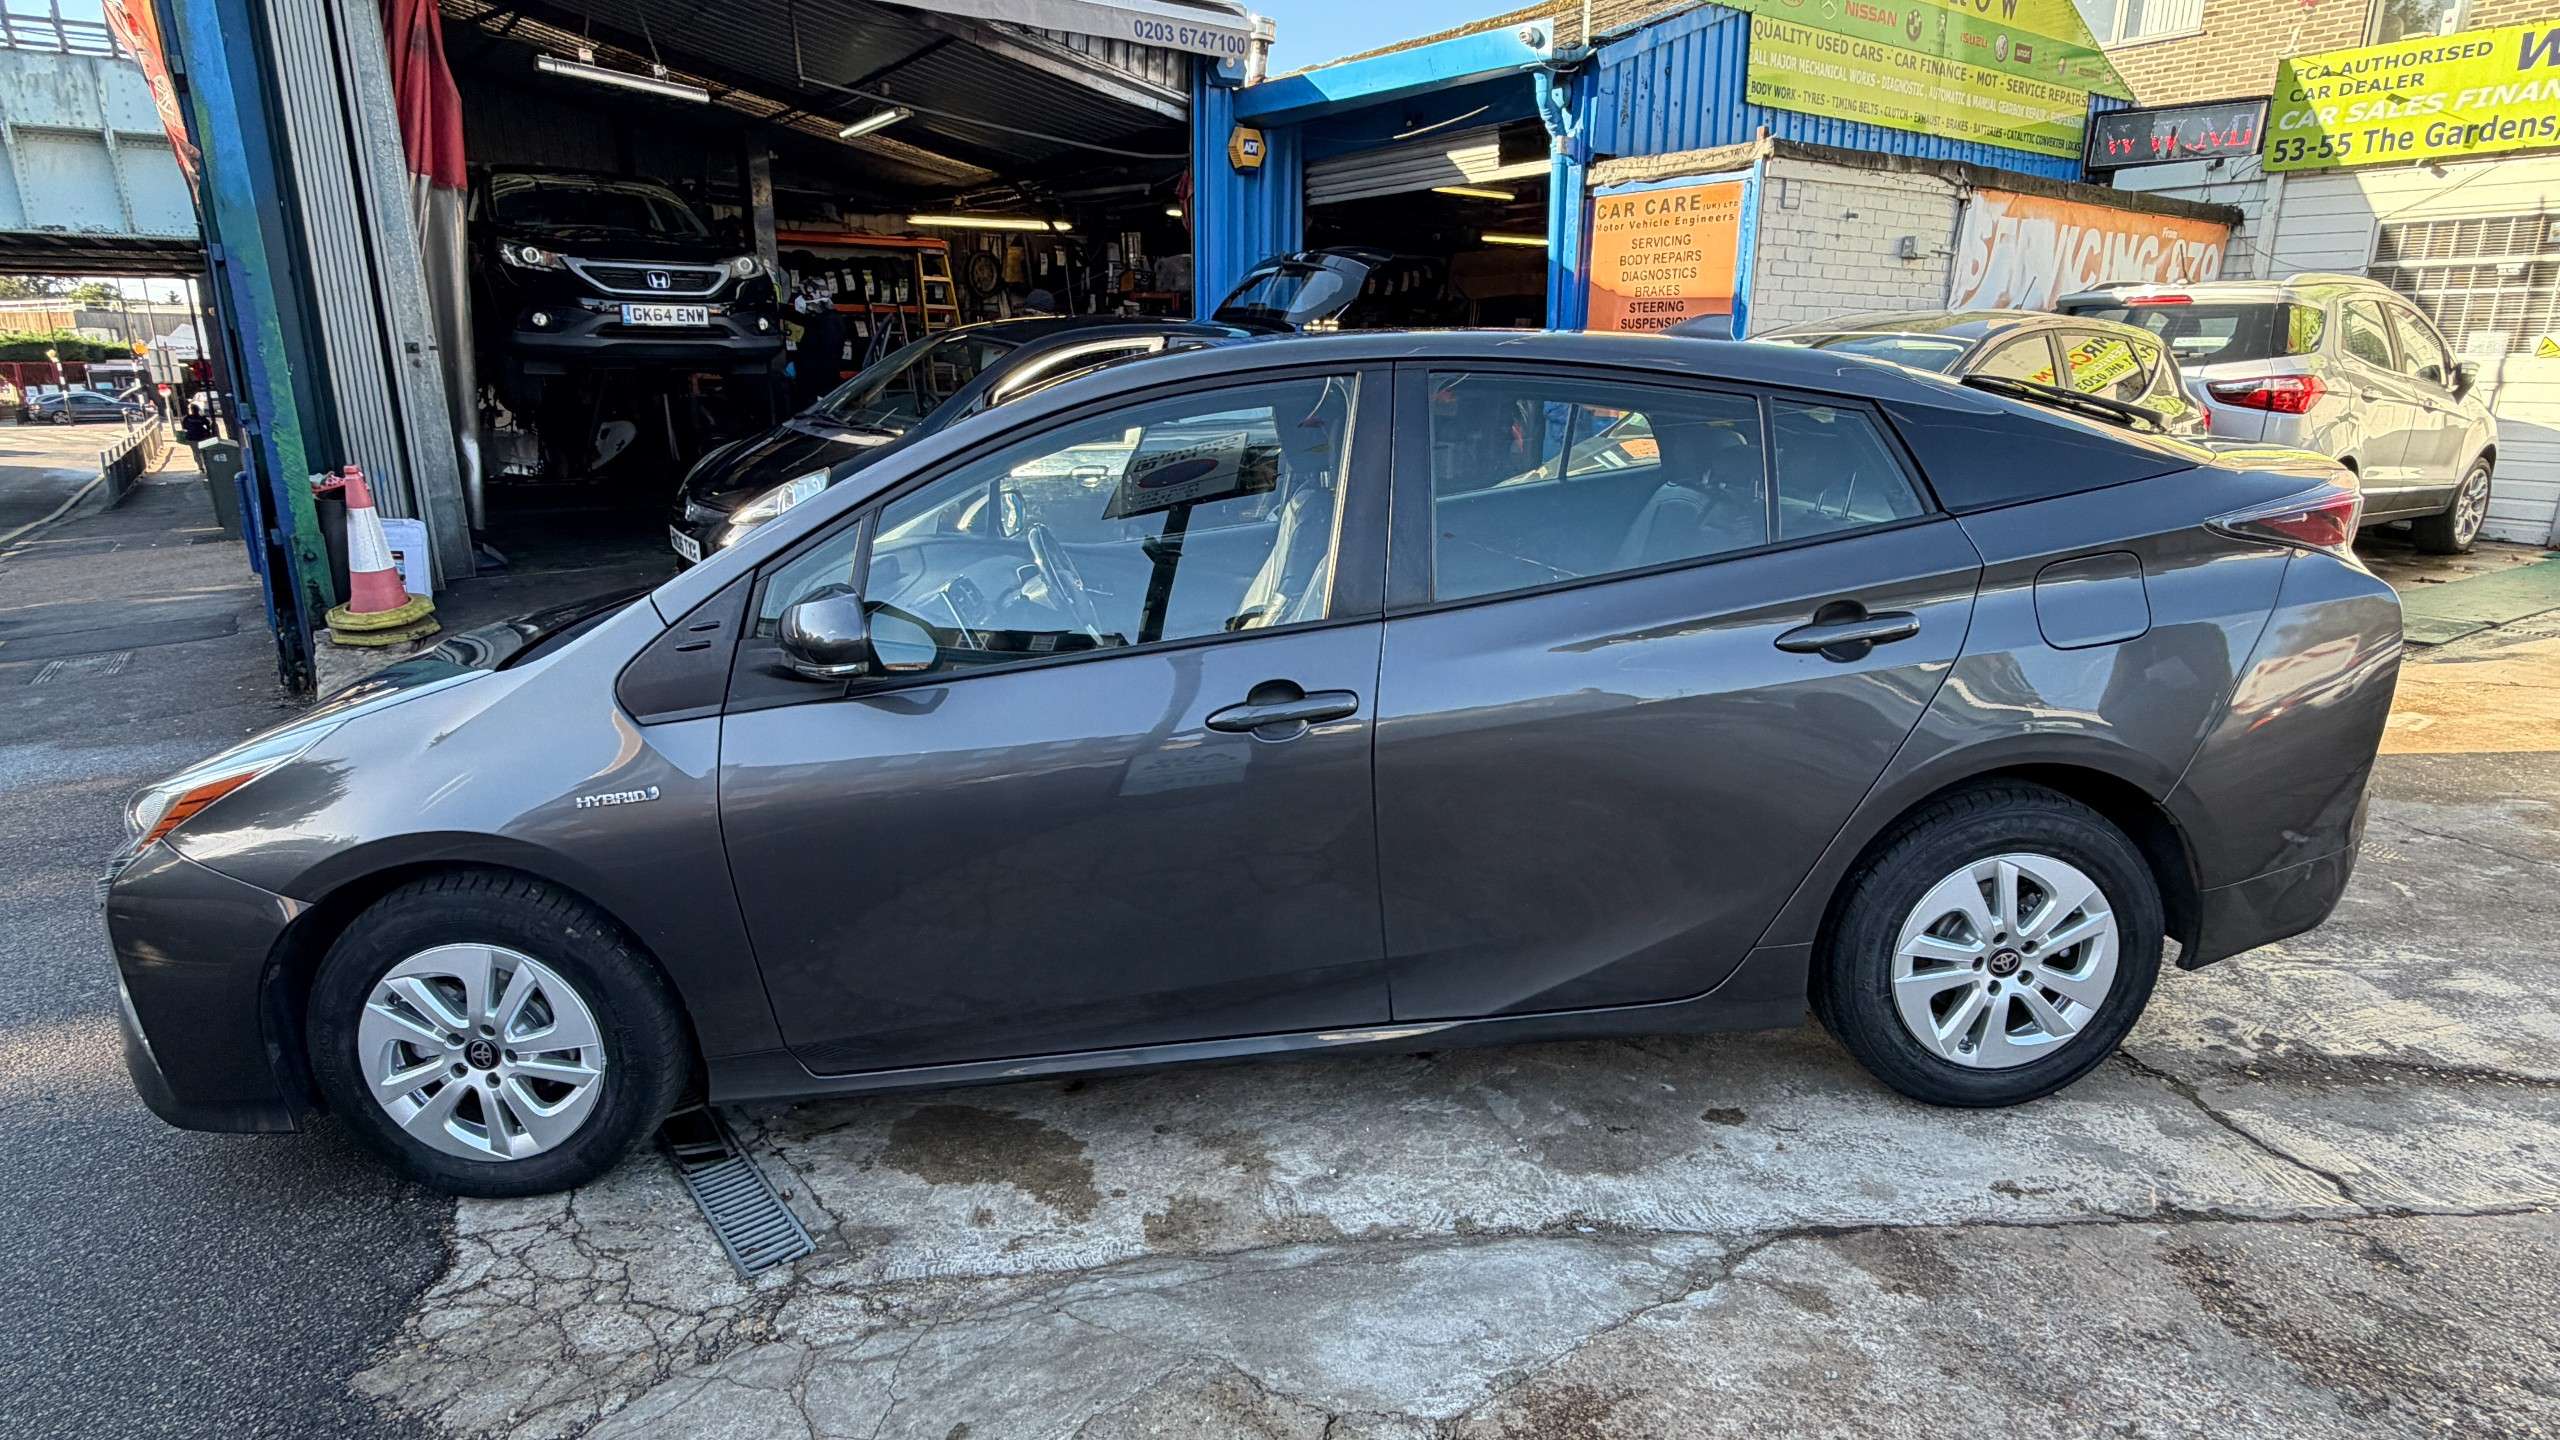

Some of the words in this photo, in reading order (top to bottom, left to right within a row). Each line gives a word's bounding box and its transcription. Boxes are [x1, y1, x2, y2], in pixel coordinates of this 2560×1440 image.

[1845, 0, 1897, 27] NISSAN
[1135, 20, 1173, 41] 0203
[1180, 27, 1245, 54] 6747100
[1753, 49, 1768, 65] ALL
[1770, 53, 1796, 70] MAJOR
[1799, 58, 1848, 82] MECHANICAL
[1850, 69, 1876, 86] WORKS
[1754, 20, 1812, 46] QUALITY
[1816, 34, 1848, 55] USED
[1853, 43, 1883, 62] CARS
[1895, 53, 1916, 70] CAR
[1921, 57, 1966, 81] FINANCE
[1977, 72, 1998, 88] MOT
[2007, 79, 2046, 99] SERVICE
[2049, 88, 2088, 108] REPAIRS
[2294, 66, 2330, 81] FCA
[2341, 41, 2493, 76] AUTHORISED
[2290, 86, 2331, 102] CAR
[2339, 73, 2425, 96] DEALER
[1752, 81, 1771, 95] BODY
[1774, 84, 1796, 100] WORK
[1803, 91, 1825, 106] TYRES
[1832, 96, 1857, 111] TIMING
[1859, 102, 1878, 115] BELTS
[1884, 106, 1908, 120] CLUTCH
[1914, 112, 1941, 127] EXHAUST
[1946, 116, 1968, 132] BRAKES
[2007, 129, 2035, 144] CATALYTIC
[2279, 107, 2338, 130] CAR
[2345, 92, 2444, 124] SALES
[2272, 133, 2352, 162] 53-55
[2364, 127, 2414, 153] The
[1597, 202, 1635, 220] CAR
[1645, 195, 1702, 215] CARE
[1703, 202, 1720, 211] (UK)
[1596, 222, 1624, 233] Motor
[1629, 218, 1670, 230] Vehicle
[1675, 213, 1735, 227] Engineers
[1631, 234, 1692, 250] SERVICING
[1620, 254, 1650, 266] BODY
[1653, 250, 1702, 264] REPAIRS
[1622, 267, 1697, 282] DIAGNOSTICS
[1635, 285, 1680, 298] BRAKES
[632, 308, 672, 322] GK64
[677, 308, 704, 322] ENW
[1629, 301, 1684, 313] STEERING
[1621, 317, 1689, 330] SUSPENSIO
[576, 790, 647, 808] HYBRID
